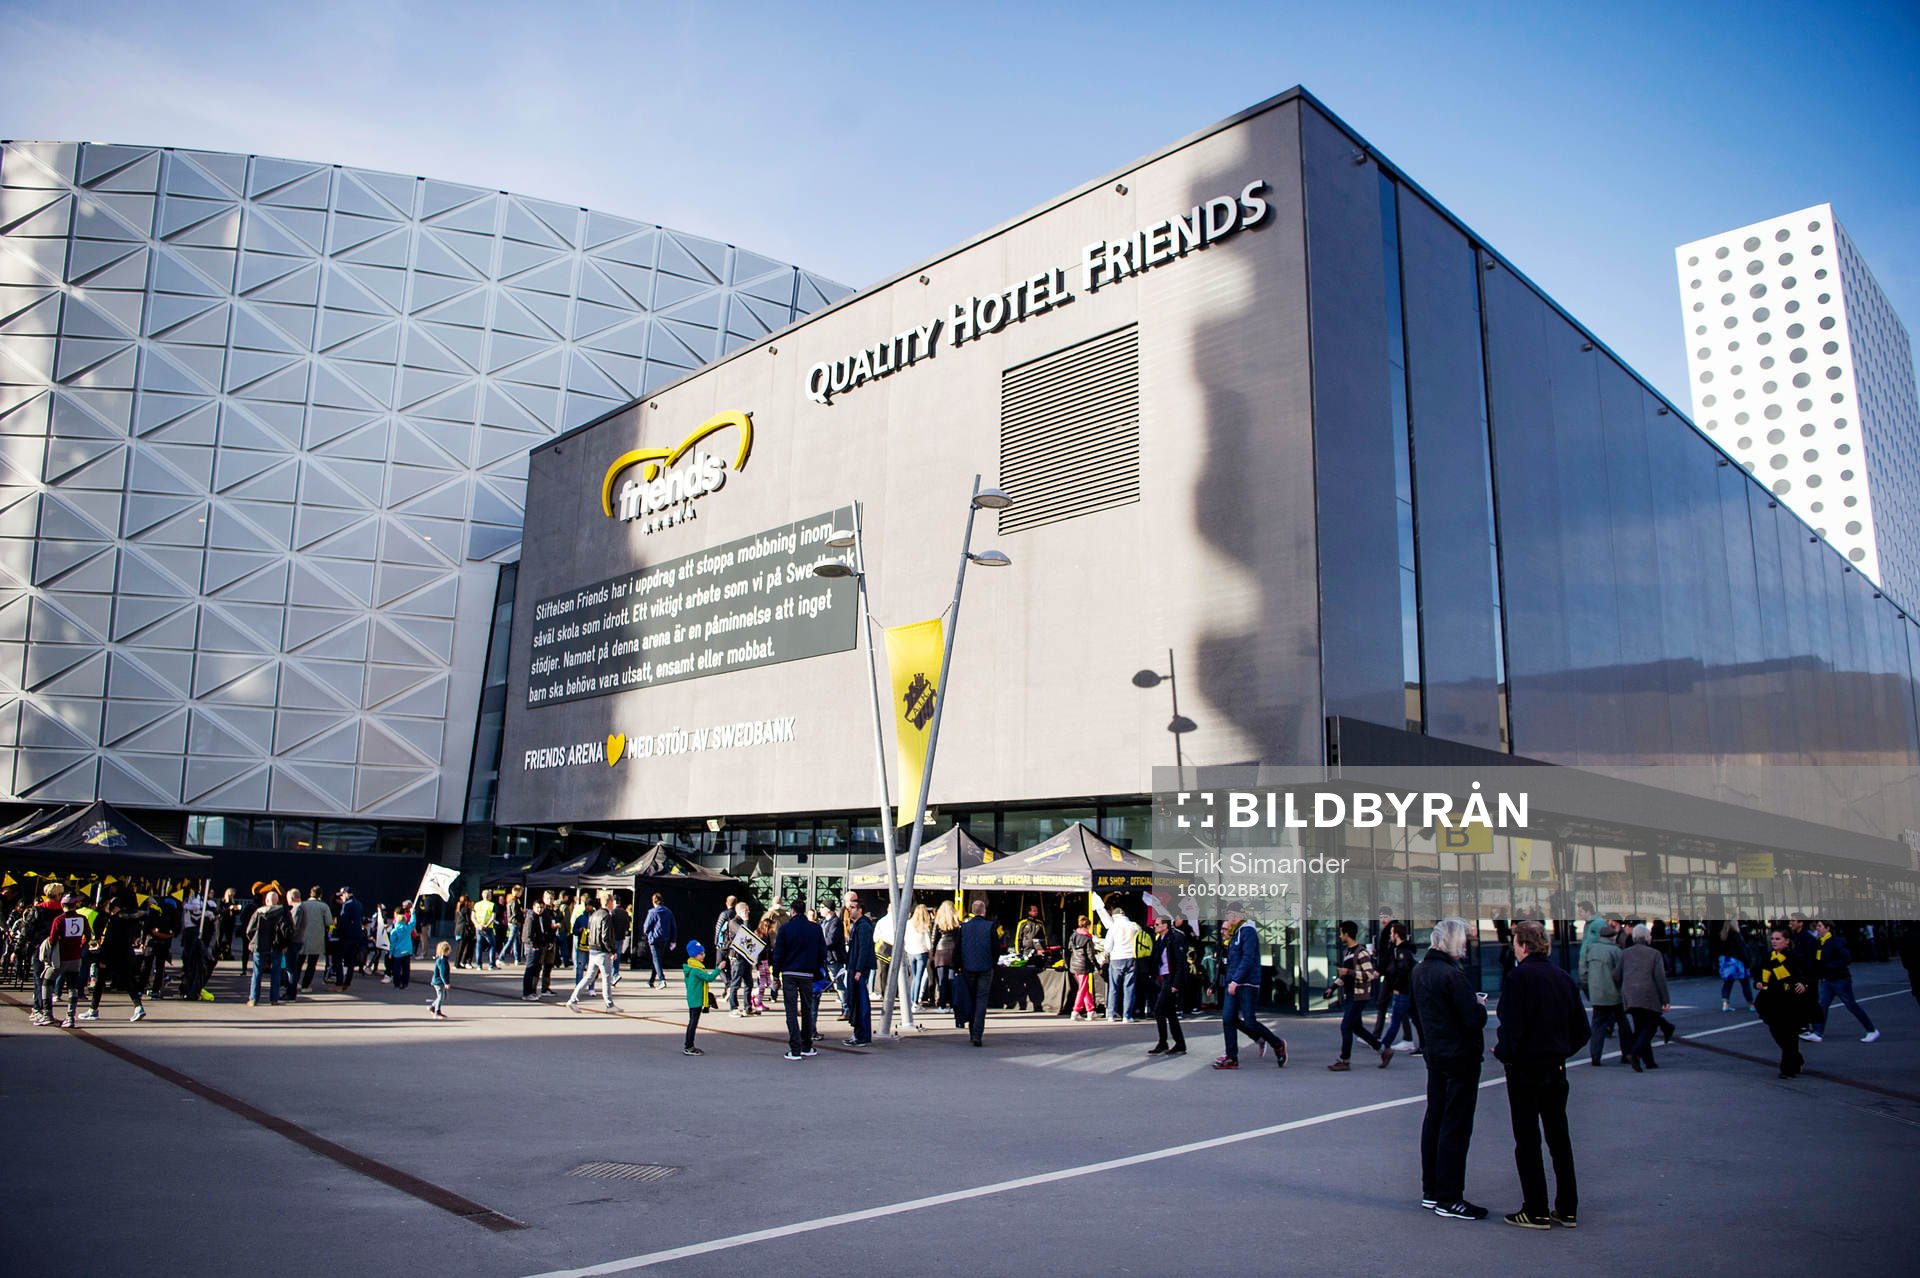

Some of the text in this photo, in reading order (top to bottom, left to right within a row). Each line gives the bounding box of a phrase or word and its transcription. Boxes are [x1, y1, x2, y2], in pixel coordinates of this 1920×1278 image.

[805, 180, 1269, 405] QUALITY HOTEL FRIENDS
[619, 450, 725, 521] friends
[641, 502, 696, 534] ARENA
[536, 523, 833, 621] Stiftelsen Friends har i uppdrag att stoppa mobbning inom
[531, 588, 832, 676] stödjer. Namnet på denna arena är en påminnelse att inget
[533, 624, 555, 648] såväl
[557, 622, 579, 640] skola
[582, 621, 600, 635] som
[603, 608, 630, 630] idrott.
[633, 601, 647, 623] Ett
[651, 597, 682, 618] viktigt
[685, 584, 721, 609] arbete
[724, 580, 748, 599] som
[752, 571, 763, 592] vi
[767, 565, 782, 594] på
[529, 635, 775, 702] barn ska behöva vara utsatt, ensamt eller mobbat.
[525, 715, 796, 771] FRIENDS ARENA MED STÖD AV SWEDBANK
[1446, 819, 1469, 847] B
[1110, 876, 1126, 886] SHOP
[70, 919, 80, 935] 5
